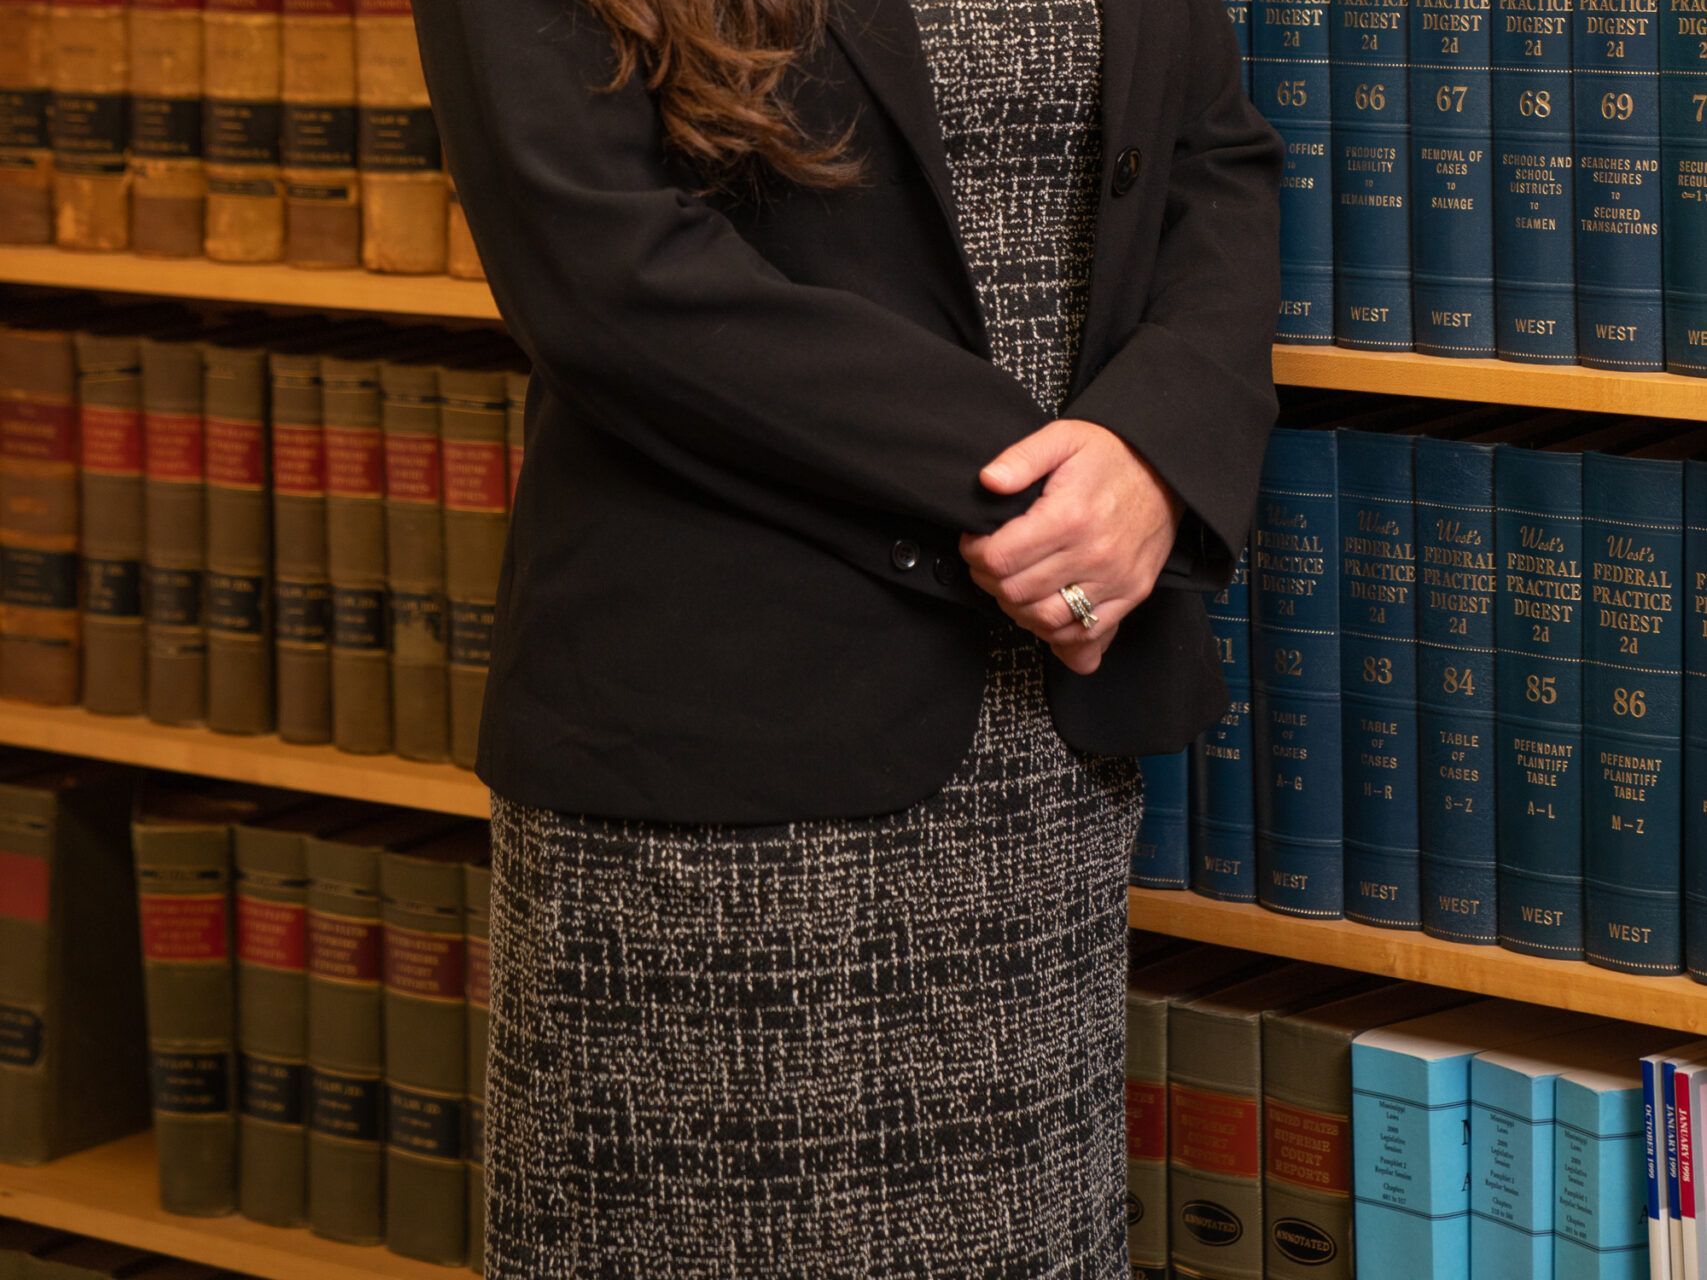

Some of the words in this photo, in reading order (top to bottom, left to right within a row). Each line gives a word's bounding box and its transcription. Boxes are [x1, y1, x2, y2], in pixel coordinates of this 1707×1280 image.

[1423, 13, 1482, 32] DIGEST
[1586, 17, 1649, 36] DIGEST
[1441, 36, 1459, 54] 2d
[1606, 41, 1624, 58] 2d
[1436, 85, 1468, 113] 67
[1519, 90, 1551, 118] 68
[1601, 92, 1634, 120] 69
[1421, 148, 1464, 161] REMOVAL
[1468, 150, 1483, 162] OF
[1502, 153, 1546, 168] SCHOOLS
[1550, 156, 1573, 168] AND
[1581, 157, 1630, 171] SEARCHES
[1635, 160, 1658, 172] AND
[1436, 163, 1468, 175] CASES
[1515, 169, 1555, 182] SCHOOL
[1593, 171, 1643, 185] SEIZURES
[1510, 182, 1563, 196] DISTRICTS
[1431, 197, 1474, 210] SALVAGE
[1593, 206, 1641, 221] SECURED
[1515, 217, 1556, 231] SEAMEN
[1581, 219, 1658, 235] TRANSACTIONS
[1431, 310, 1472, 328] WEST
[1515, 318, 1556, 335] WEST
[1595, 323, 1637, 342] WEST
[1520, 525, 1565, 553] West's
[1607, 535, 1655, 563] West's
[1507, 552, 1582, 578] FEDERAL
[1593, 563, 1672, 589] FEDERAL
[1506, 575, 1582, 601] PRACTICE
[1592, 585, 1672, 611] PRACTICE
[1514, 598, 1573, 623] DIGEST
[1600, 609, 1663, 634] DIGEST
[1532, 624, 1550, 643] 2d
[1619, 636, 1638, 654] 2d
[1443, 666, 1476, 696] 84
[1526, 674, 1557, 705] 85
[1613, 687, 1647, 718] 86
[1514, 738, 1573, 757] DEFENDANT
[1517, 754, 1568, 772] PLAINTIFF
[1601, 752, 1662, 771] DEFENDANT
[1527, 771, 1557, 787] TABLE
[1604, 768, 1657, 787] PLAINTIFF
[1614, 785, 1645, 802] TABLE
[1521, 906, 1564, 926] WEST
[1608, 923, 1652, 943] WEST
[1302, 1116, 1339, 1136] STATES
[1645, 1104, 1654, 1156] OCTOBER
[1667, 1104, 1676, 1155] JANUARY
[1679, 1107, 1690, 1159] JANUARY
[1274, 1128, 1331, 1152] SUPREME
[1281, 1146, 1323, 1167] COURT
[1275, 1160, 1330, 1184] REPORTS
[1647, 1157, 1655, 1179] 1999
[1276, 1229, 1330, 1252] ANNOTATED
